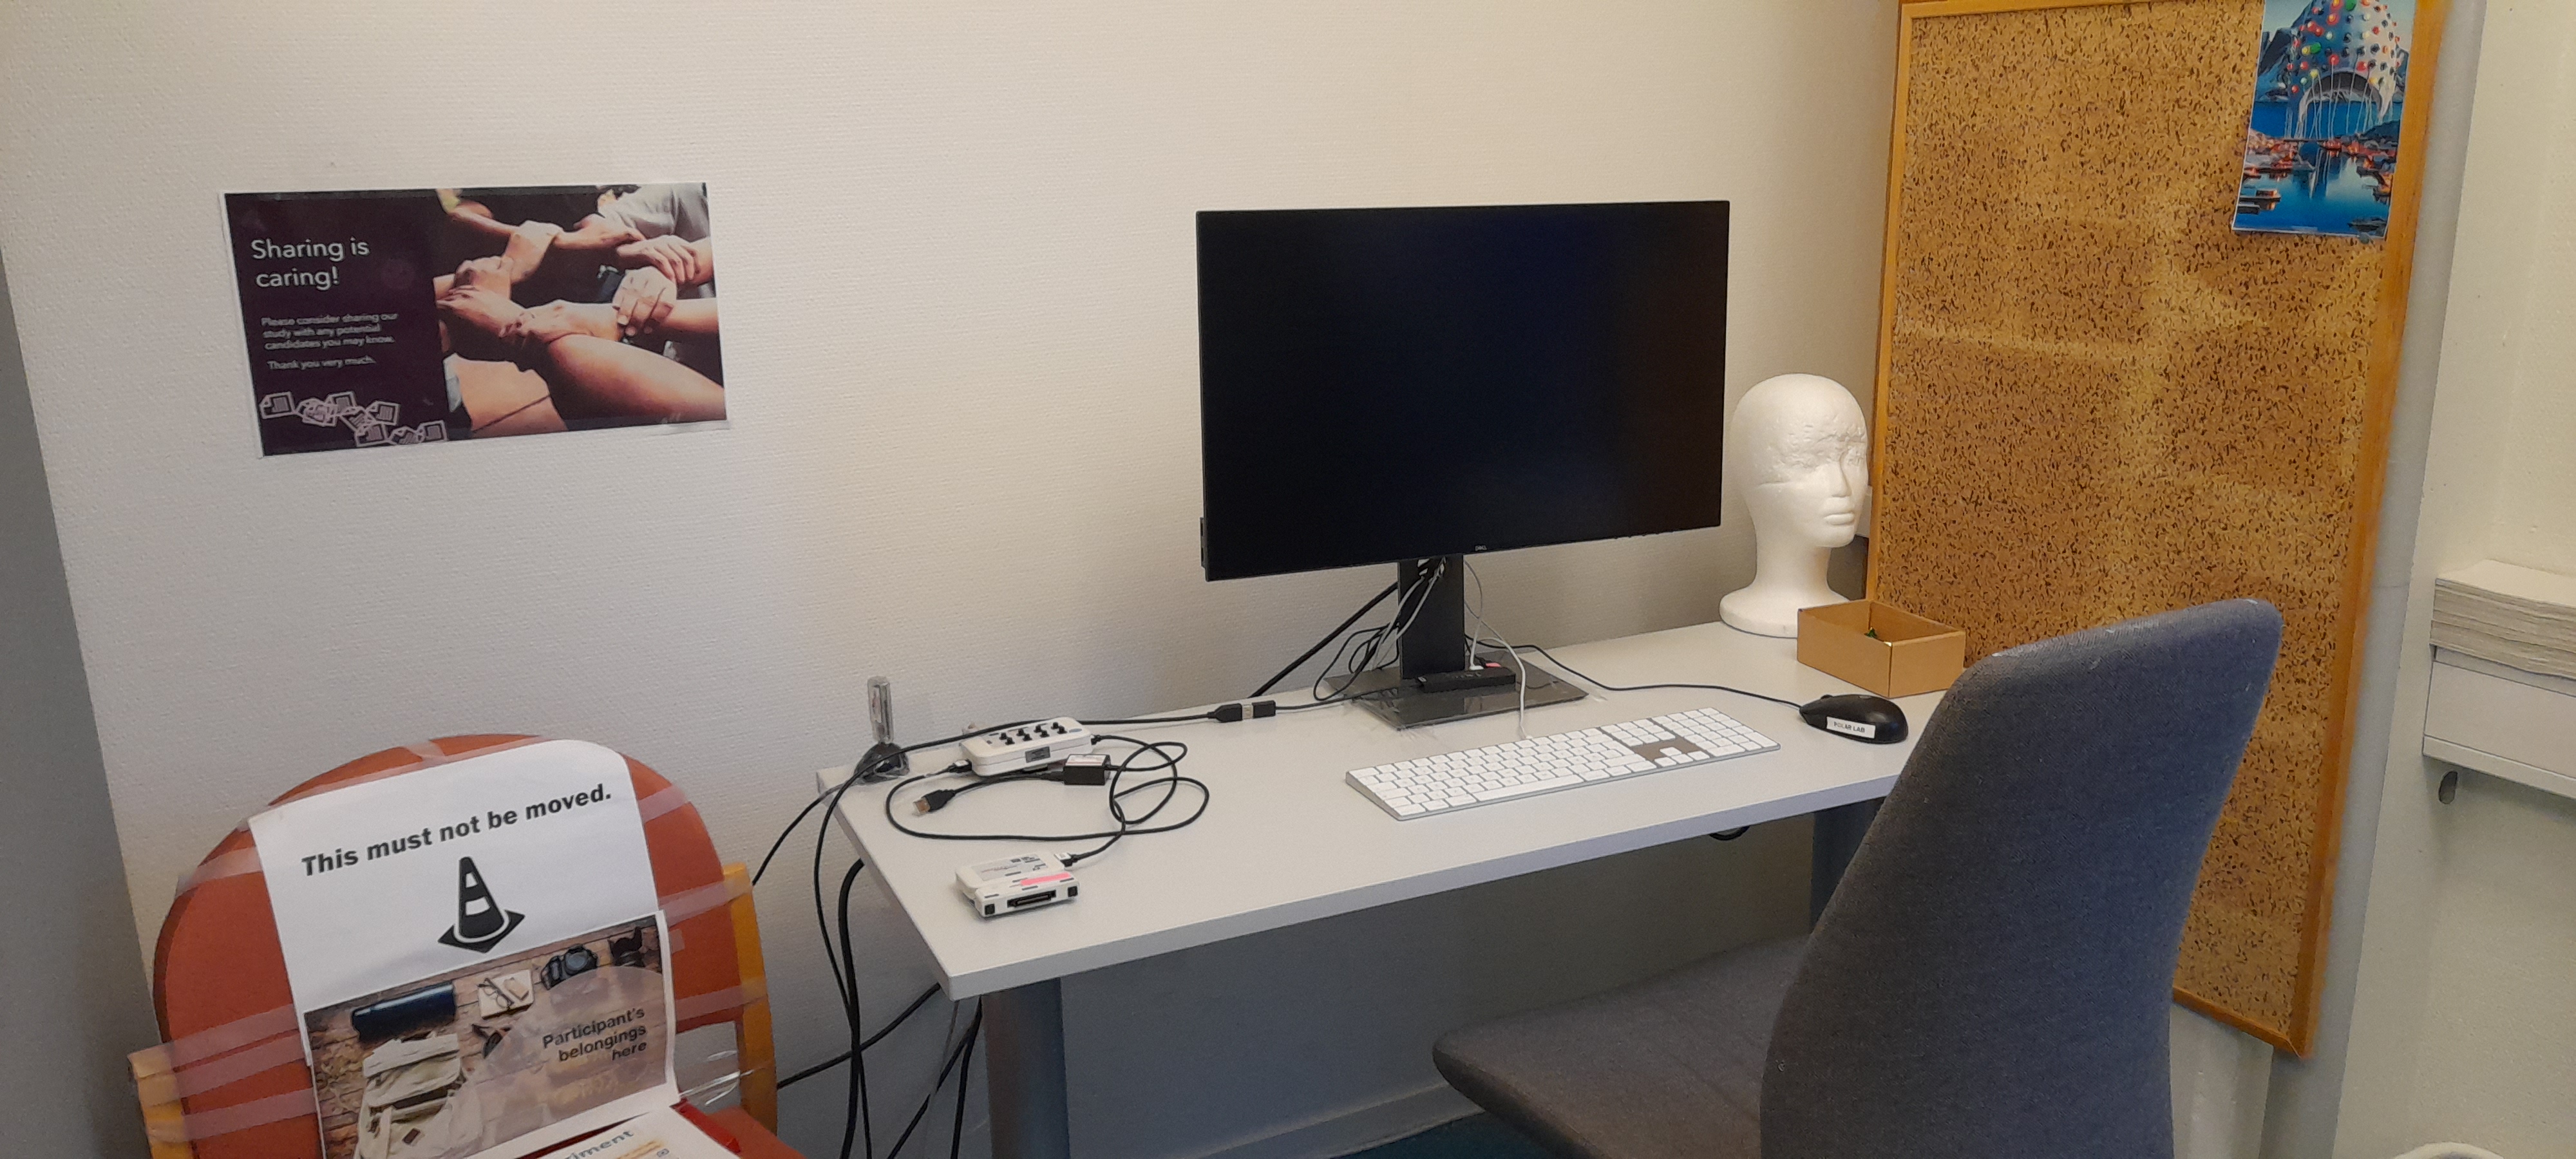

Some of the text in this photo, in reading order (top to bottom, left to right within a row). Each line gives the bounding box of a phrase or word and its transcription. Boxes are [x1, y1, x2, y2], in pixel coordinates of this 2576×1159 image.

[251, 236, 370, 261] Sharing is
[256, 265, 340, 291] caring!
[296, 315, 340, 325] consider
[322, 339, 341, 348] you
[342, 338, 365, 347] may
[300, 361, 321, 370] you
[322, 359, 344, 368] very
[301, 784, 612, 876] This must not be moved.
[542, 1008, 645, 1049] Participant's
[558, 1026, 647, 1062] belongings
[612, 1041, 647, 1060] here
